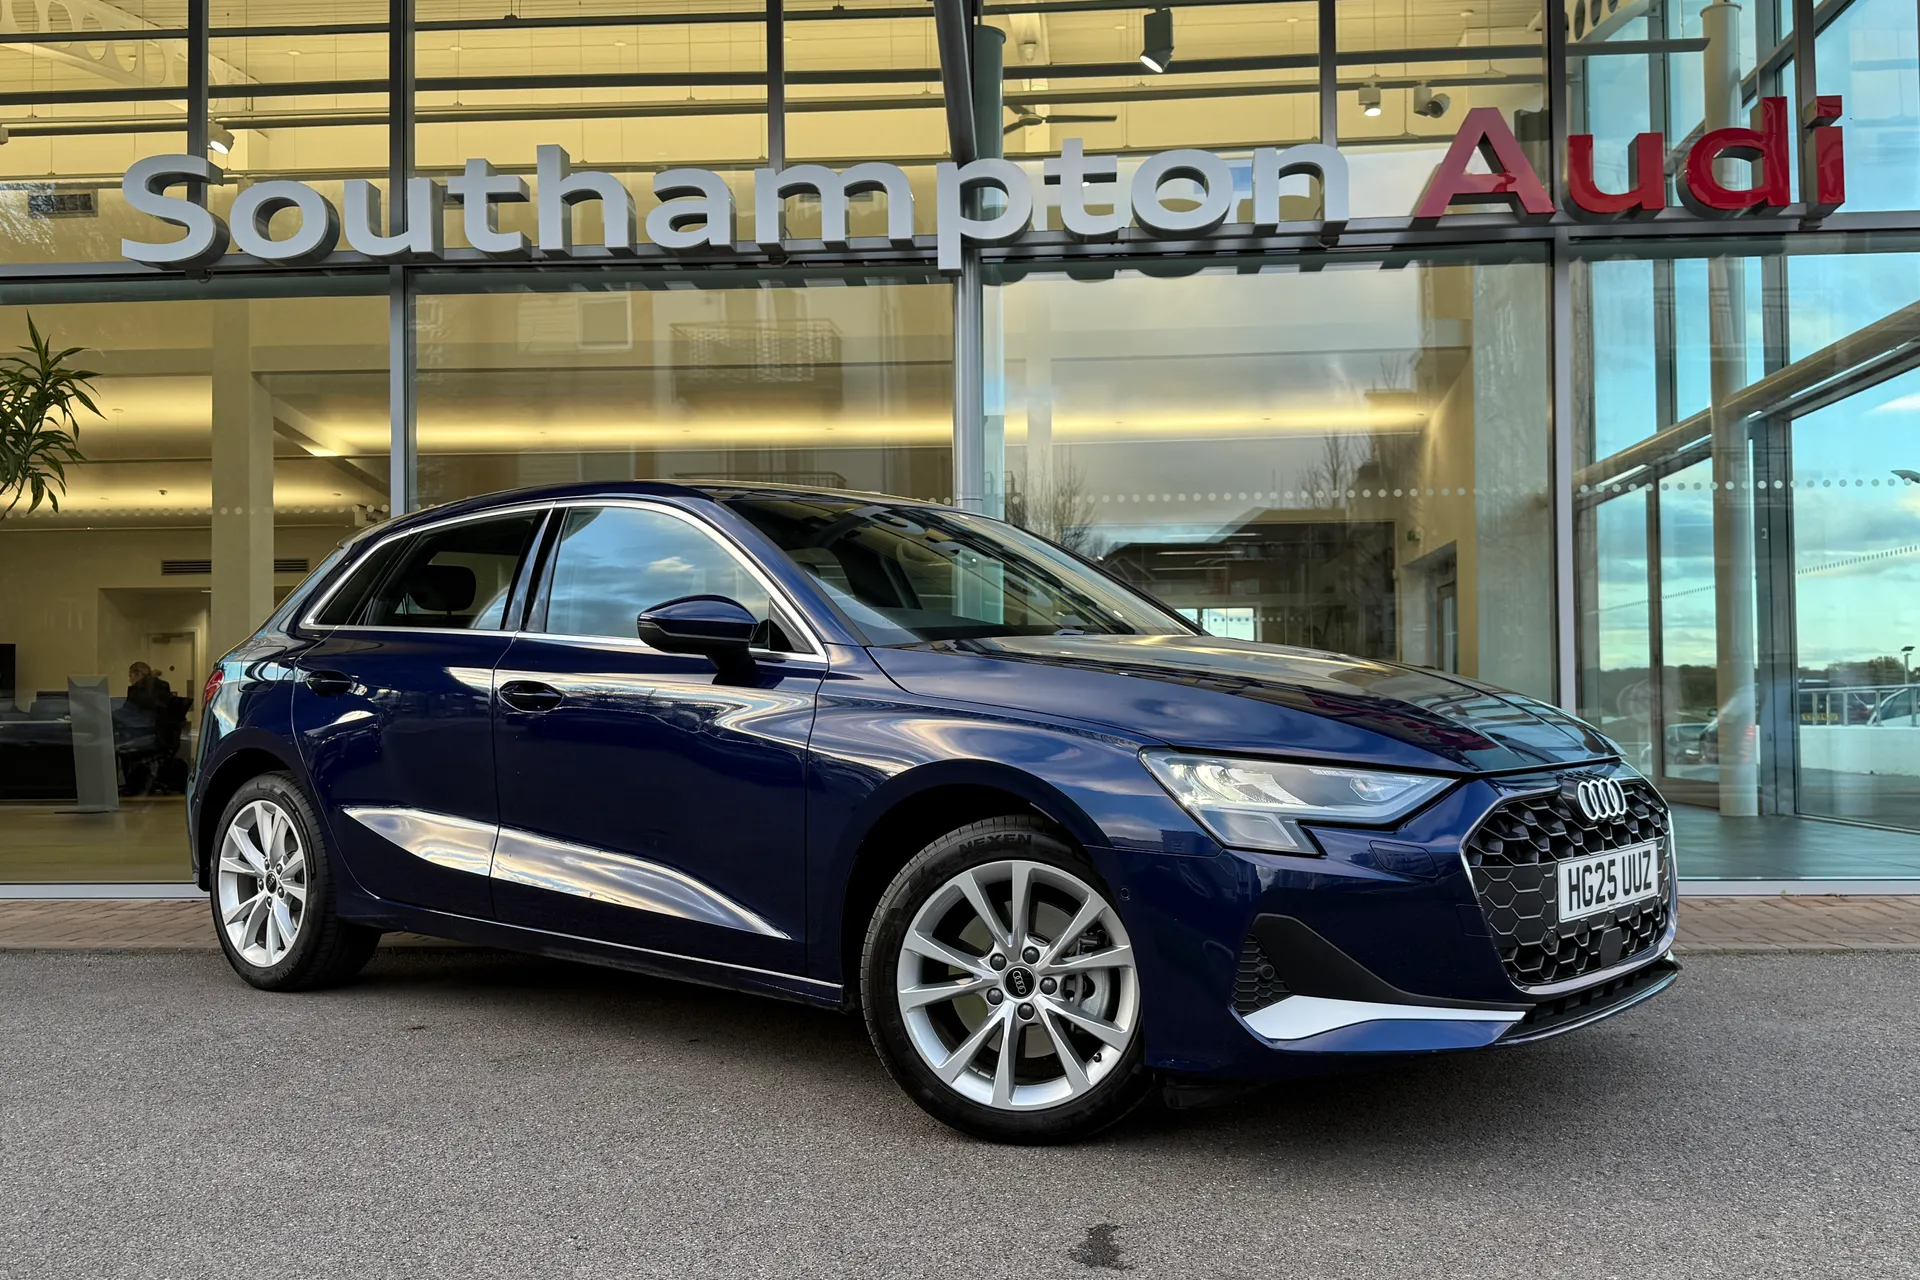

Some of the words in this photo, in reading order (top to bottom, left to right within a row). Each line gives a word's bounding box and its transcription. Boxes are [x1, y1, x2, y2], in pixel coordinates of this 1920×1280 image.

[121, 144, 1349, 271] Southampton
[1412, 94, 1845, 221] Audi
[958, 833, 1032, 853] NEXEN
[1568, 858, 1617, 912] HG25
[1622, 849, 1652, 896] UUZ
